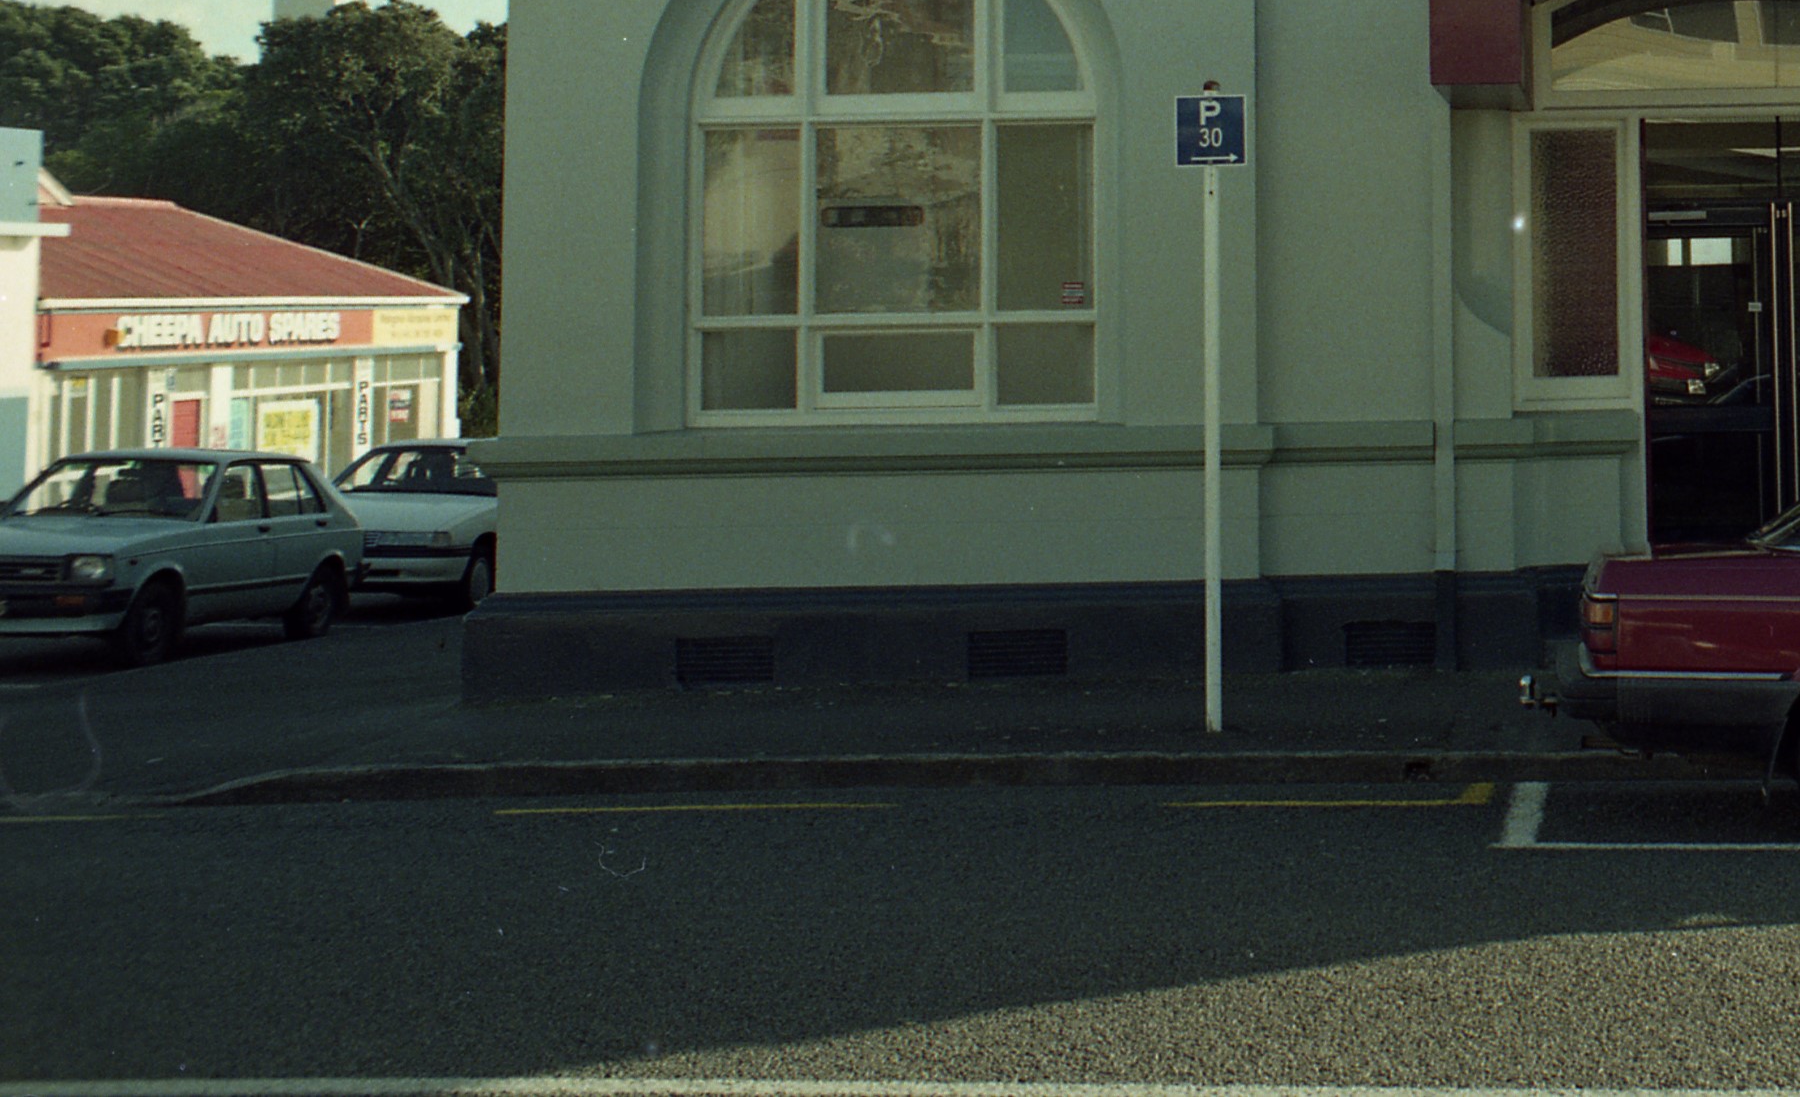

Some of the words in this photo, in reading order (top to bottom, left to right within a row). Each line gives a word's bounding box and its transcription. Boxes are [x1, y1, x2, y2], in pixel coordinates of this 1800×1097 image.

[1200, 100, 1220, 125] P
[1199, 128, 1222, 147] 30
[116, 314, 203, 350] CHEEPA
[206, 313, 263, 348] AUTO
[269, 312, 340, 345] SPARES
[152, 393, 164, 449] PART
[358, 381, 369, 445] PARTS
